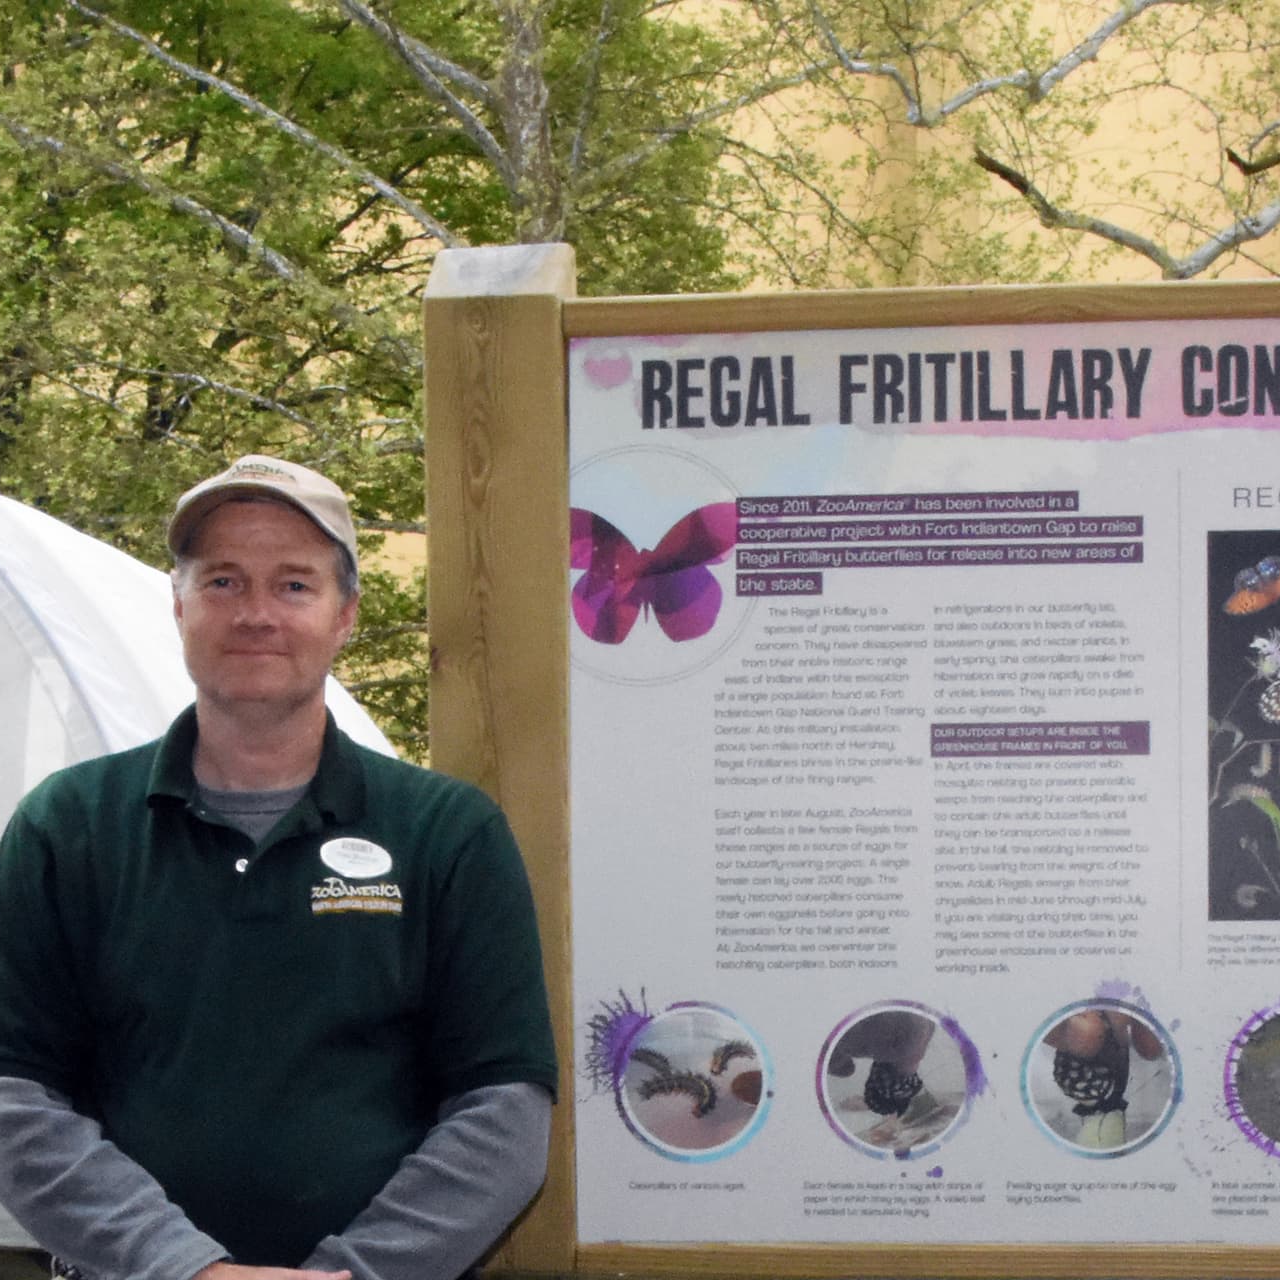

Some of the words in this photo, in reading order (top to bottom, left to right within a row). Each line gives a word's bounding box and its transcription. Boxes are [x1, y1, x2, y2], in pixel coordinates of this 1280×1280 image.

[642, 355, 811, 429] REGAL
[839, 347, 1151, 426] FRITILLARY
[740, 499, 778, 514] Since
[783, 498, 811, 516] 2011,
[915, 496, 941, 511] has
[945, 495, 981, 510] been
[986, 494, 1044, 510] involved
[1048, 494, 1061, 509] in
[1065, 496, 1074, 509] a
[739, 523, 826, 542] cooperative
[831, 522, 884, 541] project
[889, 522, 920, 537] with
[925, 521, 957, 536] Fort
[961, 520, 1041, 535] Indiantown
[1046, 520, 1075, 538] Gap
[1080, 519, 1097, 534] to
[1101, 519, 1136, 534] raise
[738, 549, 779, 568] Regal
[783, 548, 841, 567] Fritillary
[845, 547, 922, 562] butterflies
[927, 547, 946, 562] for
[951, 546, 1003, 561] release
[1008, 545, 1037, 561] into
[1041, 547, 1071, 560] new
[1076, 547, 1115, 560] areas
[1120, 544, 1134, 559] of
[739, 576, 765, 591] the
[934, 728, 954, 737] OUR
[957, 728, 1004, 737] OUTDOOR
[1047, 727, 1065, 736] ARE
[1102, 726, 1119, 735] THE
[1001, 742, 1040, 751] FRAMES
[1043, 742, 1052, 751] IN
[1054, 741, 1085, 750] FRONT
[1090, 741, 1102, 750] OF
